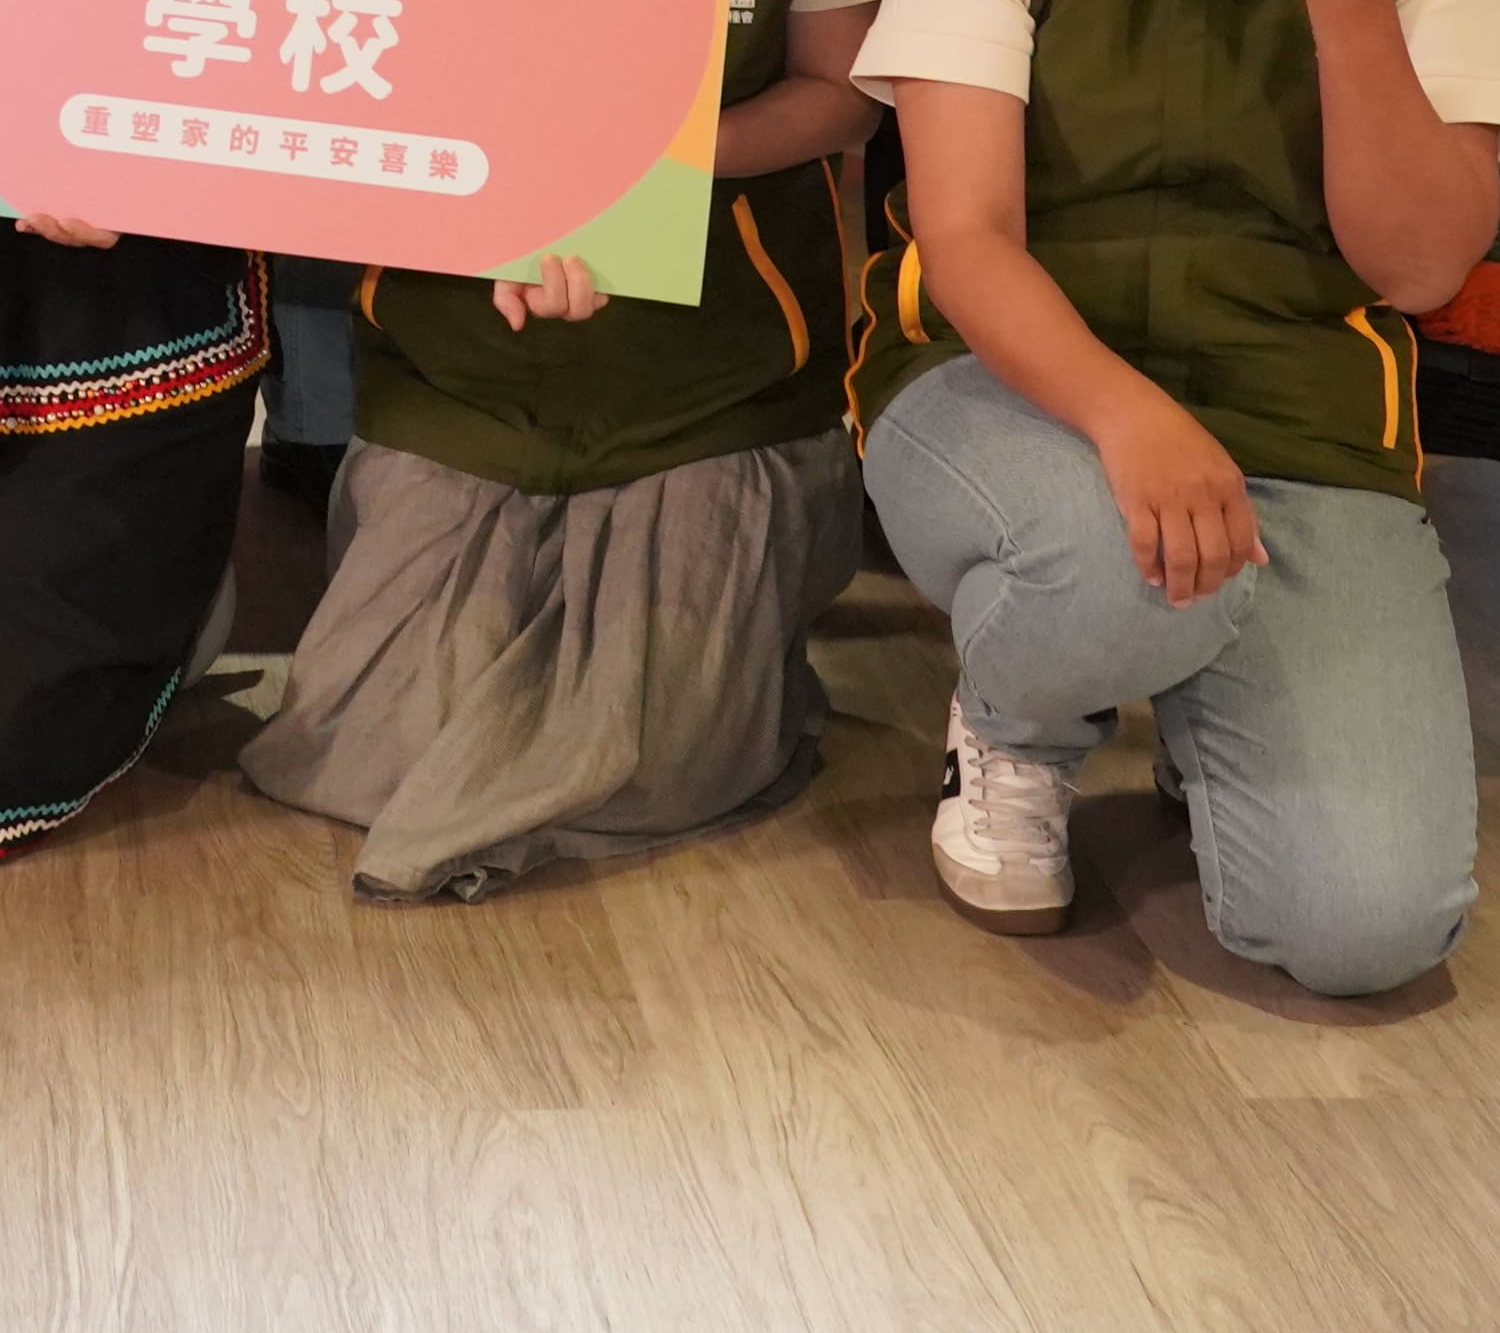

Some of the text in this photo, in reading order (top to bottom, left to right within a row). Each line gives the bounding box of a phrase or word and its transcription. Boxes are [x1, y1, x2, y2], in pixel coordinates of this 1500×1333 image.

[81, 105, 460, 181] 重塑家的平安喜樂
